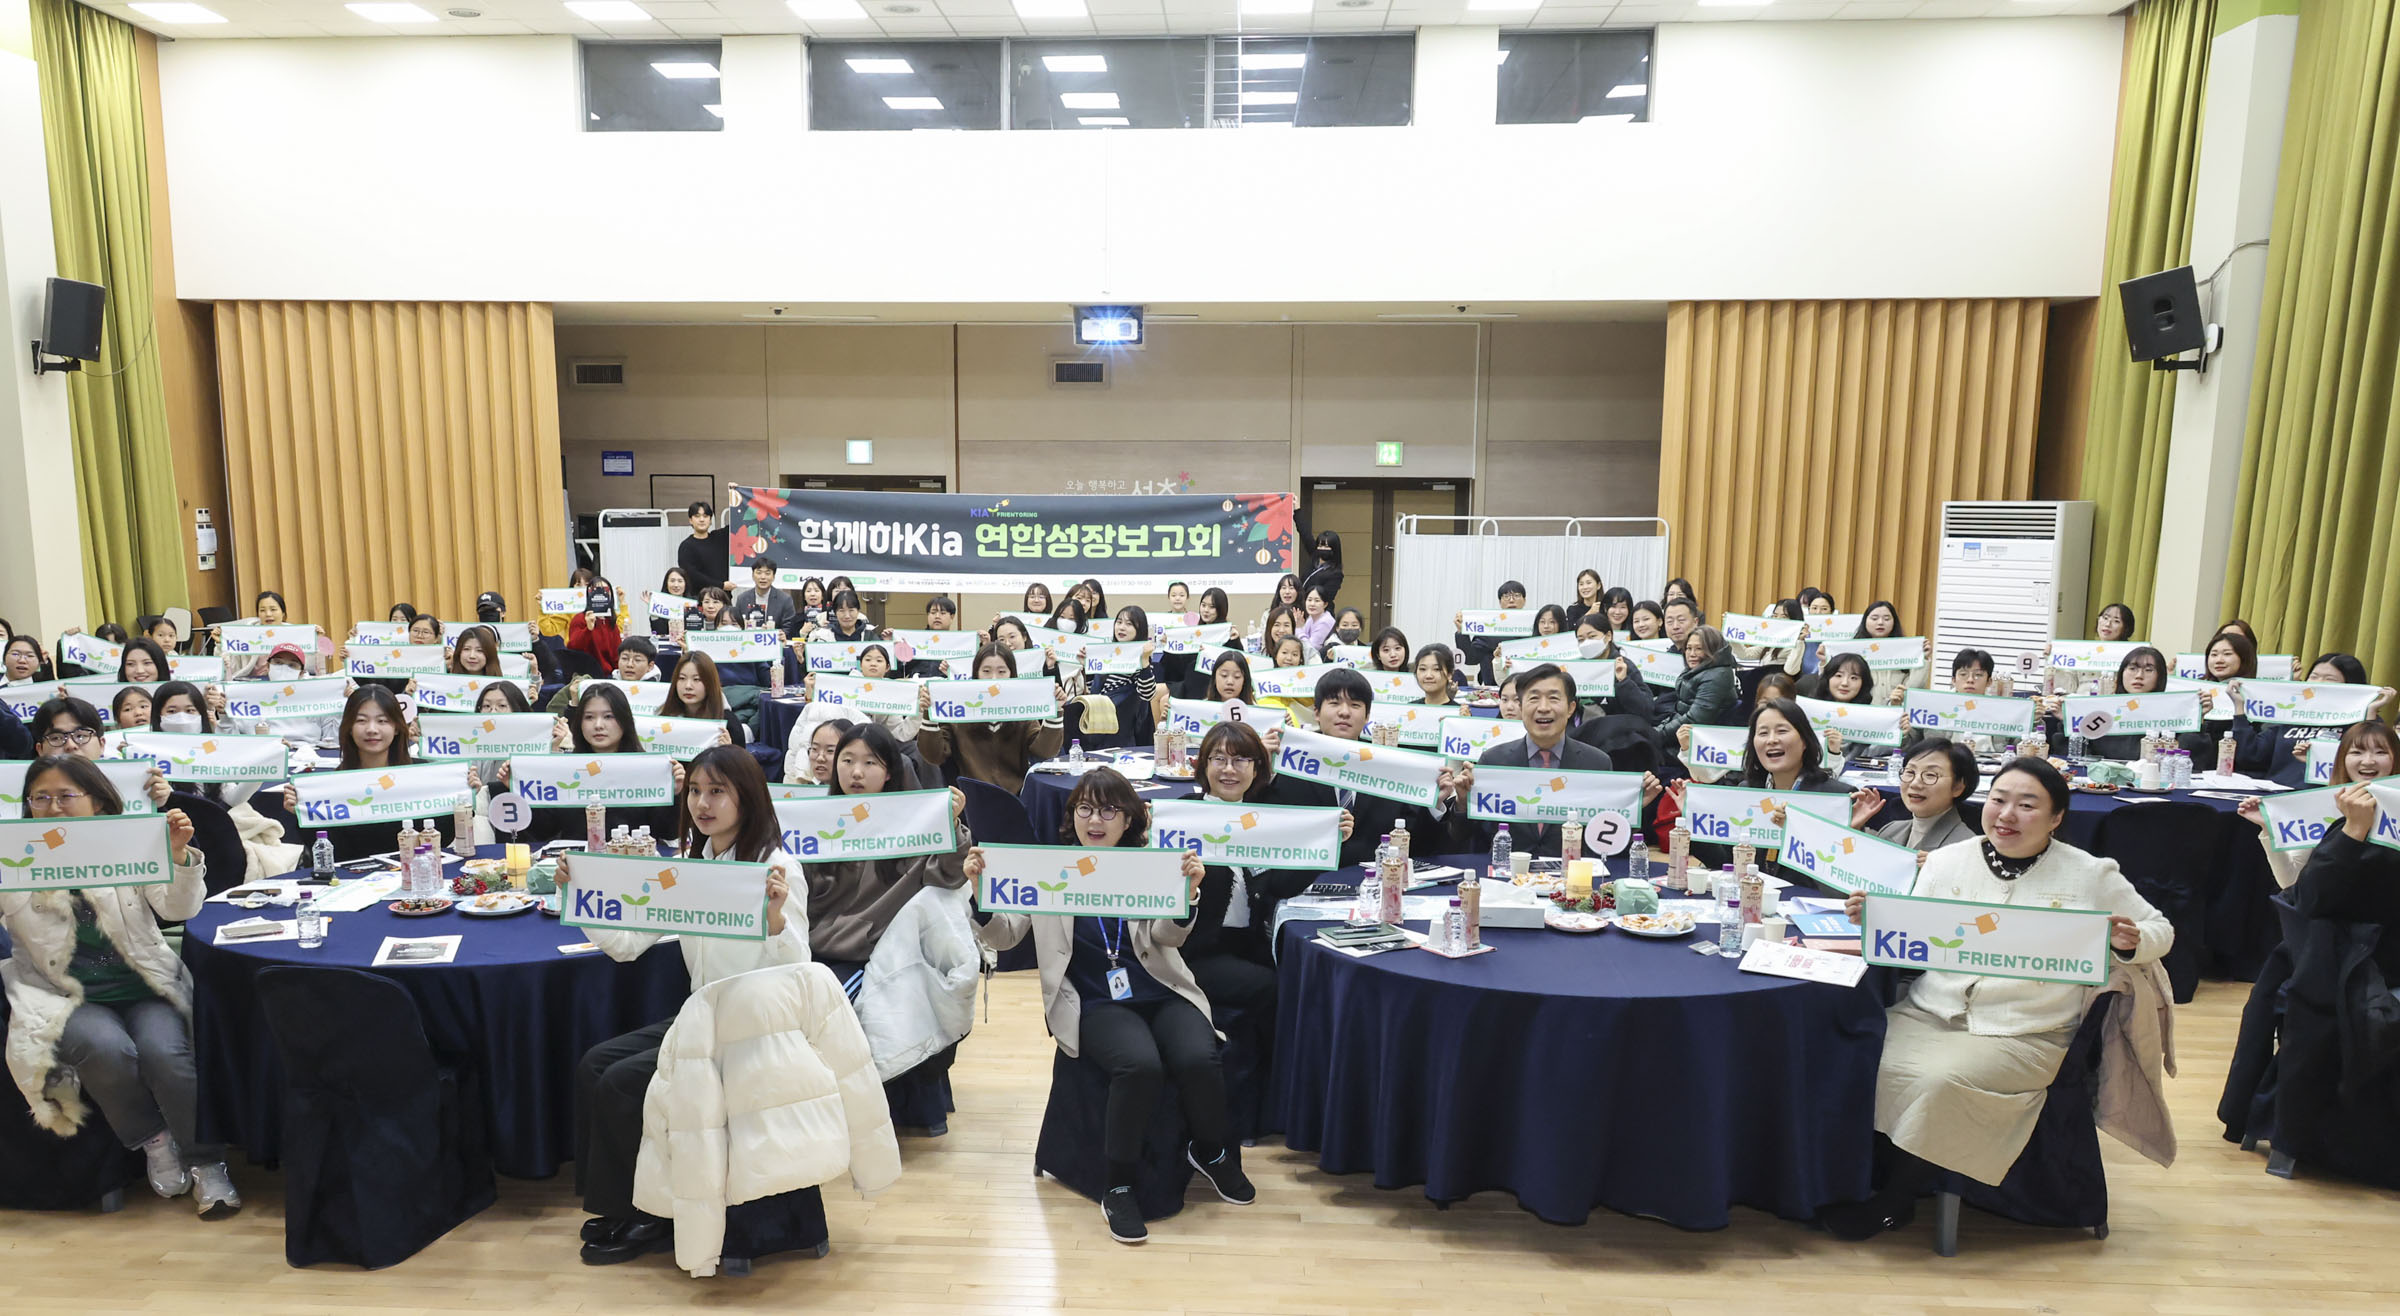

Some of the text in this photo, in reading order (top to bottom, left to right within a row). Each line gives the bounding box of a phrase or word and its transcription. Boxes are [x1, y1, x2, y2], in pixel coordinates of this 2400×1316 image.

[1065, 479, 1127, 490] 오늘 행복하고
[970, 508, 989, 518] KIA
[798, 518, 1222, 558] 함께하Kia 연합성장보고회
[545, 600, 564, 611] Kia
[652, 603, 669, 616] Kia
[1465, 621, 1485, 633] Kia
[1725, 626, 1746, 641] Kia
[226, 639, 249, 652] Kia
[359, 634, 380, 645] Kia
[754, 633, 777, 646] Kia
[1168, 640, 1184, 651] Kia
[68, 646, 87, 663] Ka
[811, 656, 833, 669] Kia
[2052, 654, 2076, 667] Kia
[351, 660, 441, 674] Kia FRIENTORING
[1088, 658, 1103, 671] Kia
[1201, 657, 1215, 671] Ki
[2023, 658, 2033, 671] 9
[1258, 681, 1282, 695] Kia
[1577, 683, 1610, 692] TORING
[419, 689, 447, 706] Kia
[818, 689, 913, 711] Kia FRIENTORING
[9, 702, 38, 719] Kia
[230, 701, 344, 717] Kia FRIENTORING
[935, 701, 1050, 718] Kia FRIENTORING
[1230, 706, 1242, 722] 6
[2246, 699, 2275, 718] Kia
[2291, 708, 2362, 721] FRIENTORING
[1909, 708, 2024, 733] Kia FRIENTORING
[2086, 716, 2106, 732] 5
[2119, 718, 2193, 730] FRIENTORING
[1399, 730, 1440, 741] FRIENTOR
[1826, 725, 1894, 740] RIENTORING
[428, 736, 460, 755] Kia
[652, 743, 703, 757] FRIENTOR
[1444, 735, 1471, 756] Kia
[1696, 745, 1728, 765] Kia
[191, 765, 278, 776] FRIENTORING
[1281, 746, 1428, 798] Kia FRIENTORING
[2315, 761, 2334, 779] Ki
[519, 780, 558, 801] Kia
[305, 796, 456, 821] Kia FRIENTORIN
[502, 802, 518, 823] 3
[1477, 793, 1516, 816] Kia
[1596, 820, 1619, 846] 2
[1692, 812, 1730, 838] Kia
[2278, 819, 2326, 843] Kia
[781, 831, 943, 855] Kia FRIENTORING
[1159, 829, 1329, 861] Kia FRIENTORING
[1786, 837, 1816, 872] Kia
[30, 860, 160, 881] FRIENTORING
[990, 878, 1176, 909] Kia FRIENTORING
[574, 888, 754, 928] Kia FRIENTORING
[1874, 929, 2093, 974] Kia FRIENTORING
